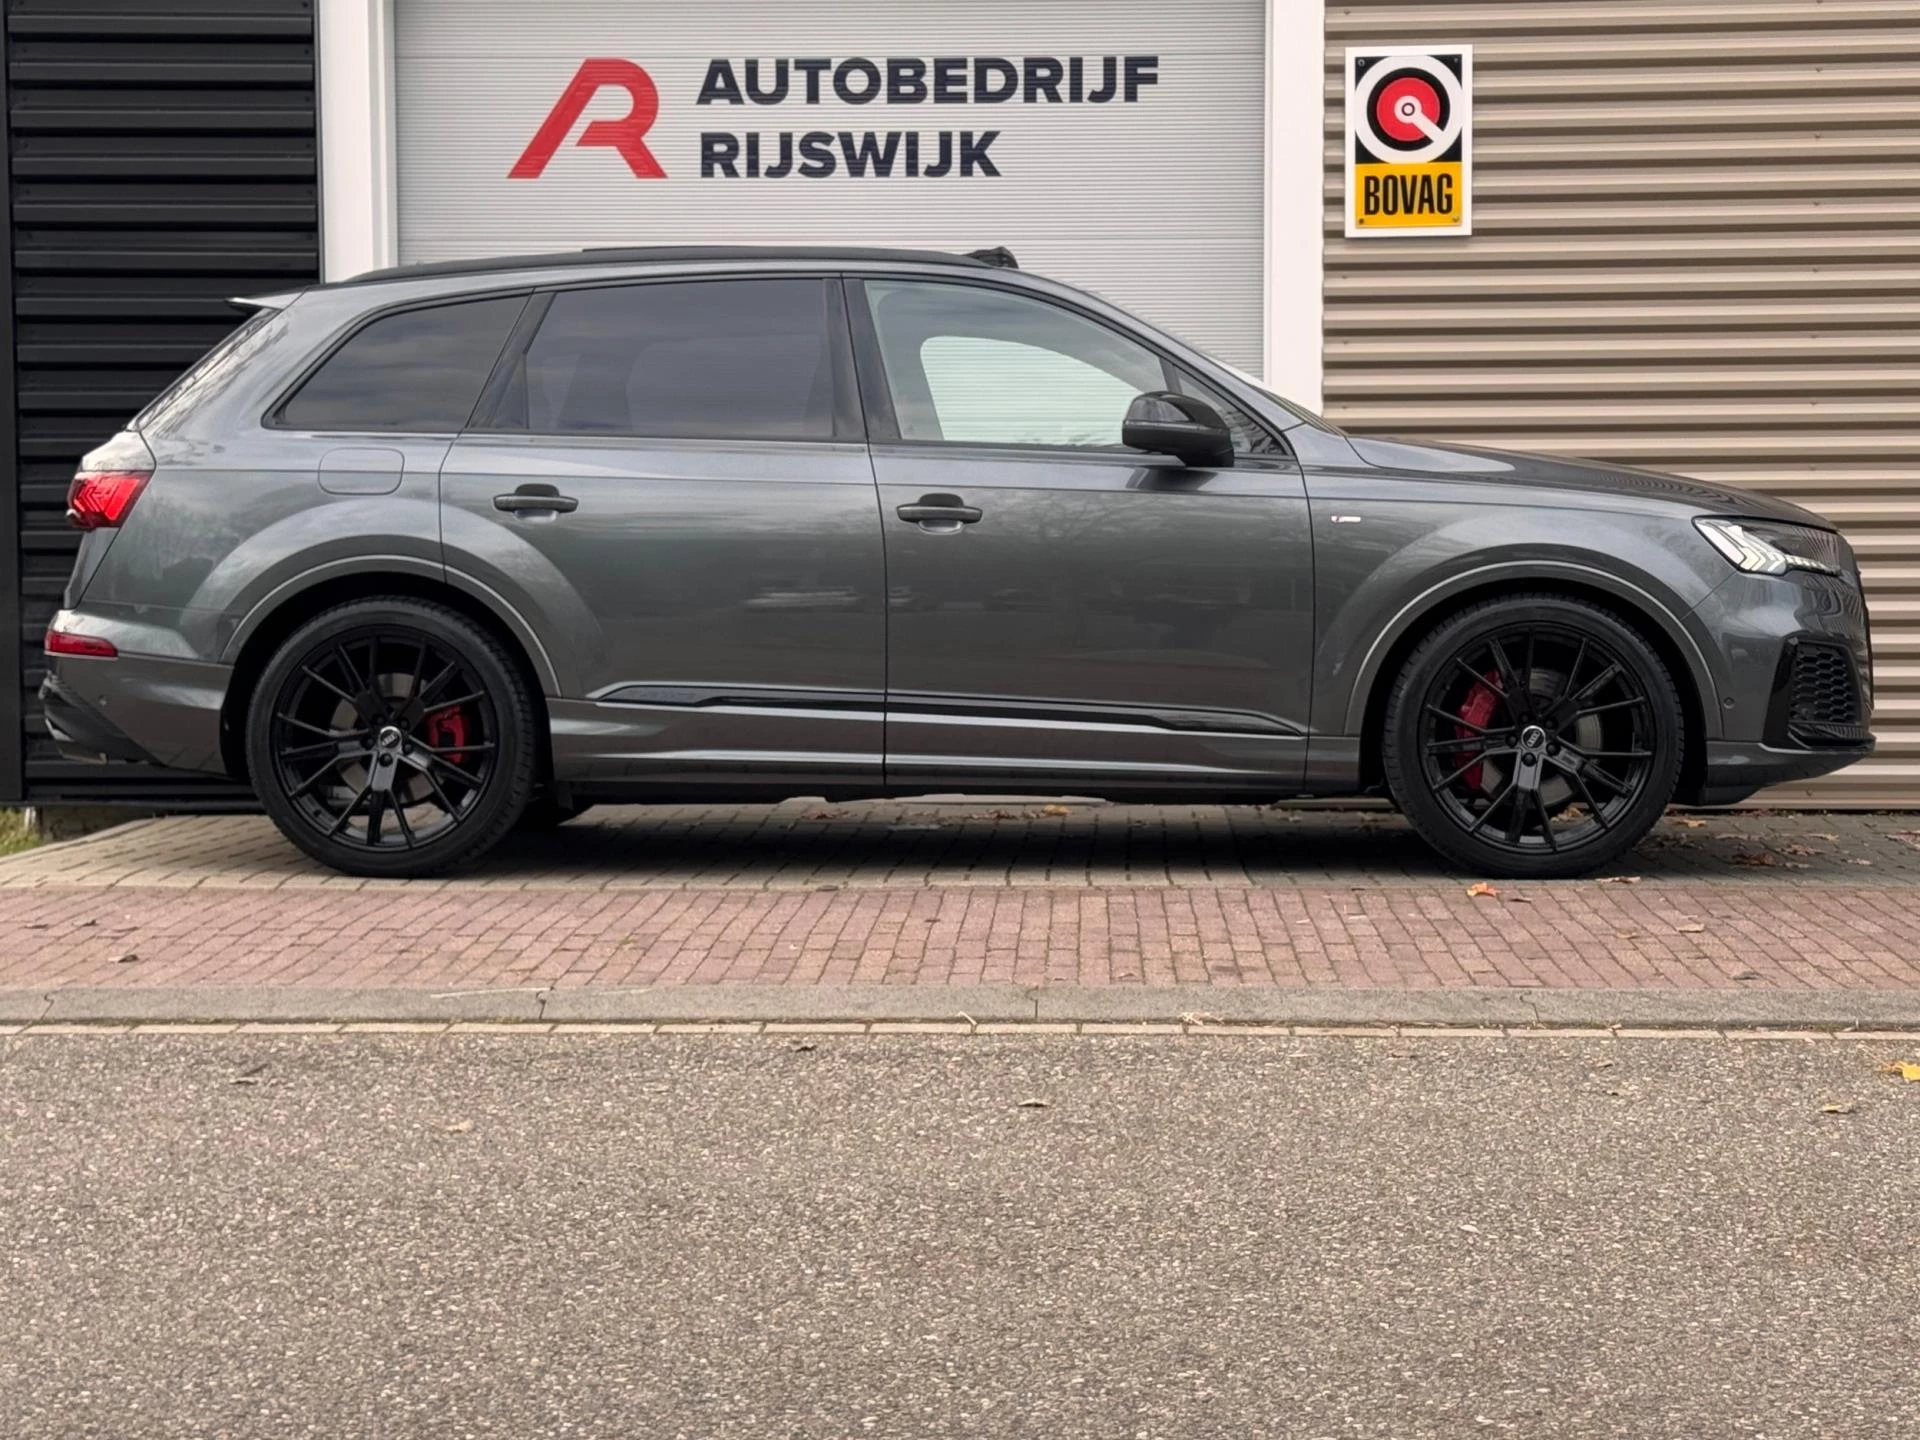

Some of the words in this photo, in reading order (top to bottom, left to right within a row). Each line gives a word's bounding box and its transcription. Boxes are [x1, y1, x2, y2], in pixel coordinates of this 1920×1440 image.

[697, 55, 1159, 105] AUTOBEDRIJF
[700, 131, 1002, 179] RIJSWIJK
[1364, 173, 1453, 216] BOVAG
